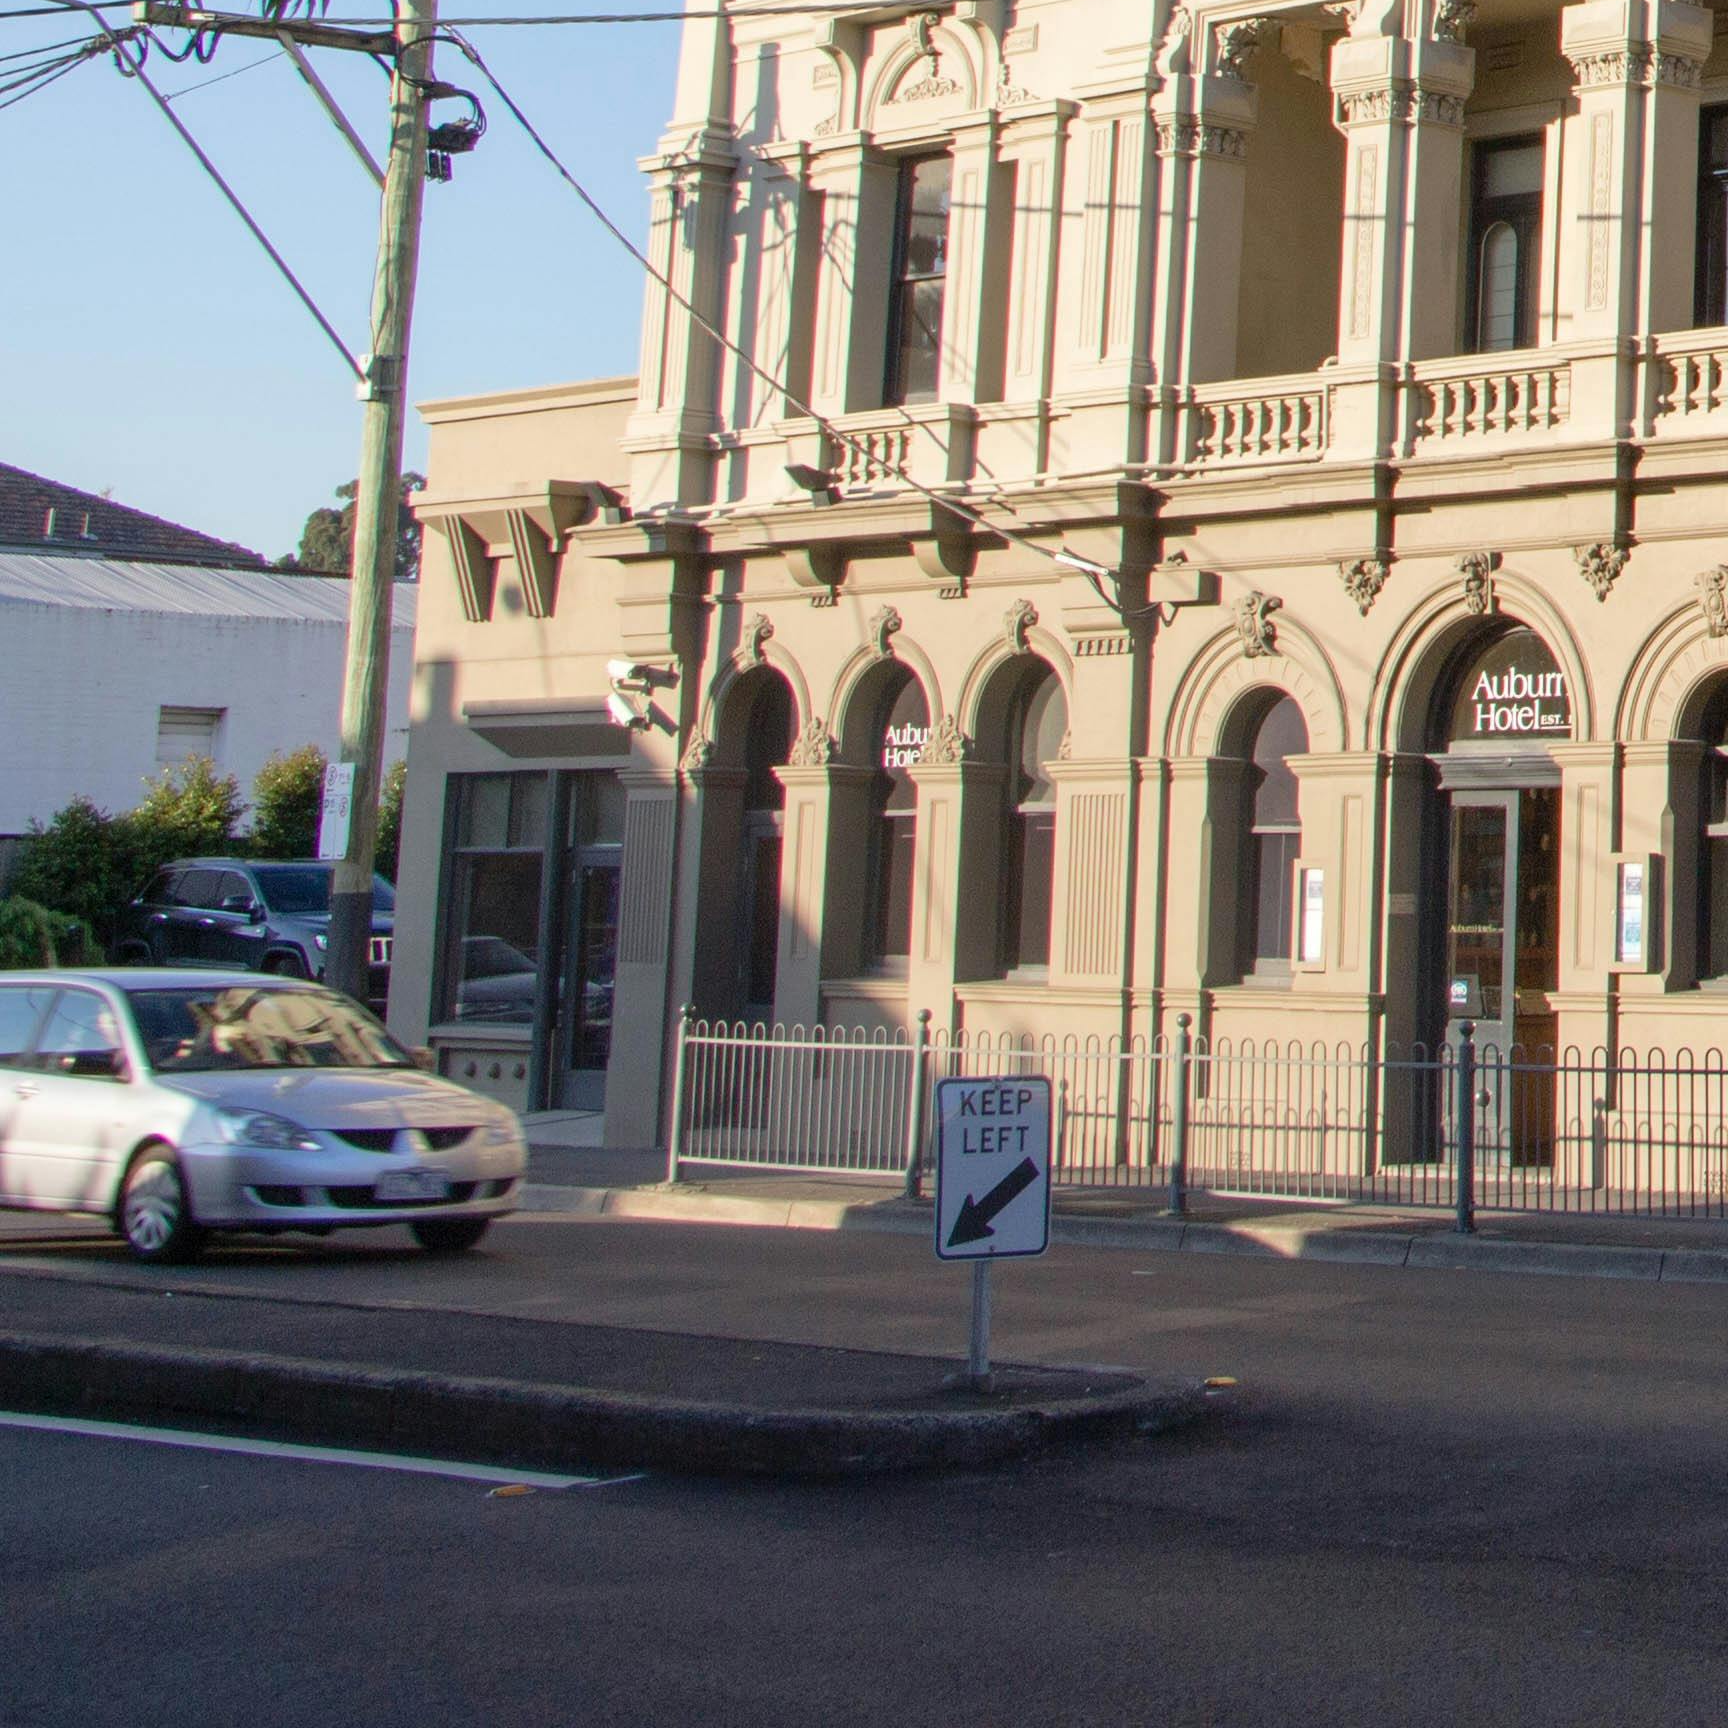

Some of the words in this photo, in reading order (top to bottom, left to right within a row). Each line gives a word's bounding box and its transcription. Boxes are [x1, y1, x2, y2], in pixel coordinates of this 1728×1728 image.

[1474, 698, 1541, 732] Hotel
[884, 722, 928, 746] Aubu
[960, 1089, 1033, 1116] KEEP
[963, 1125, 1030, 1154] LEFT
